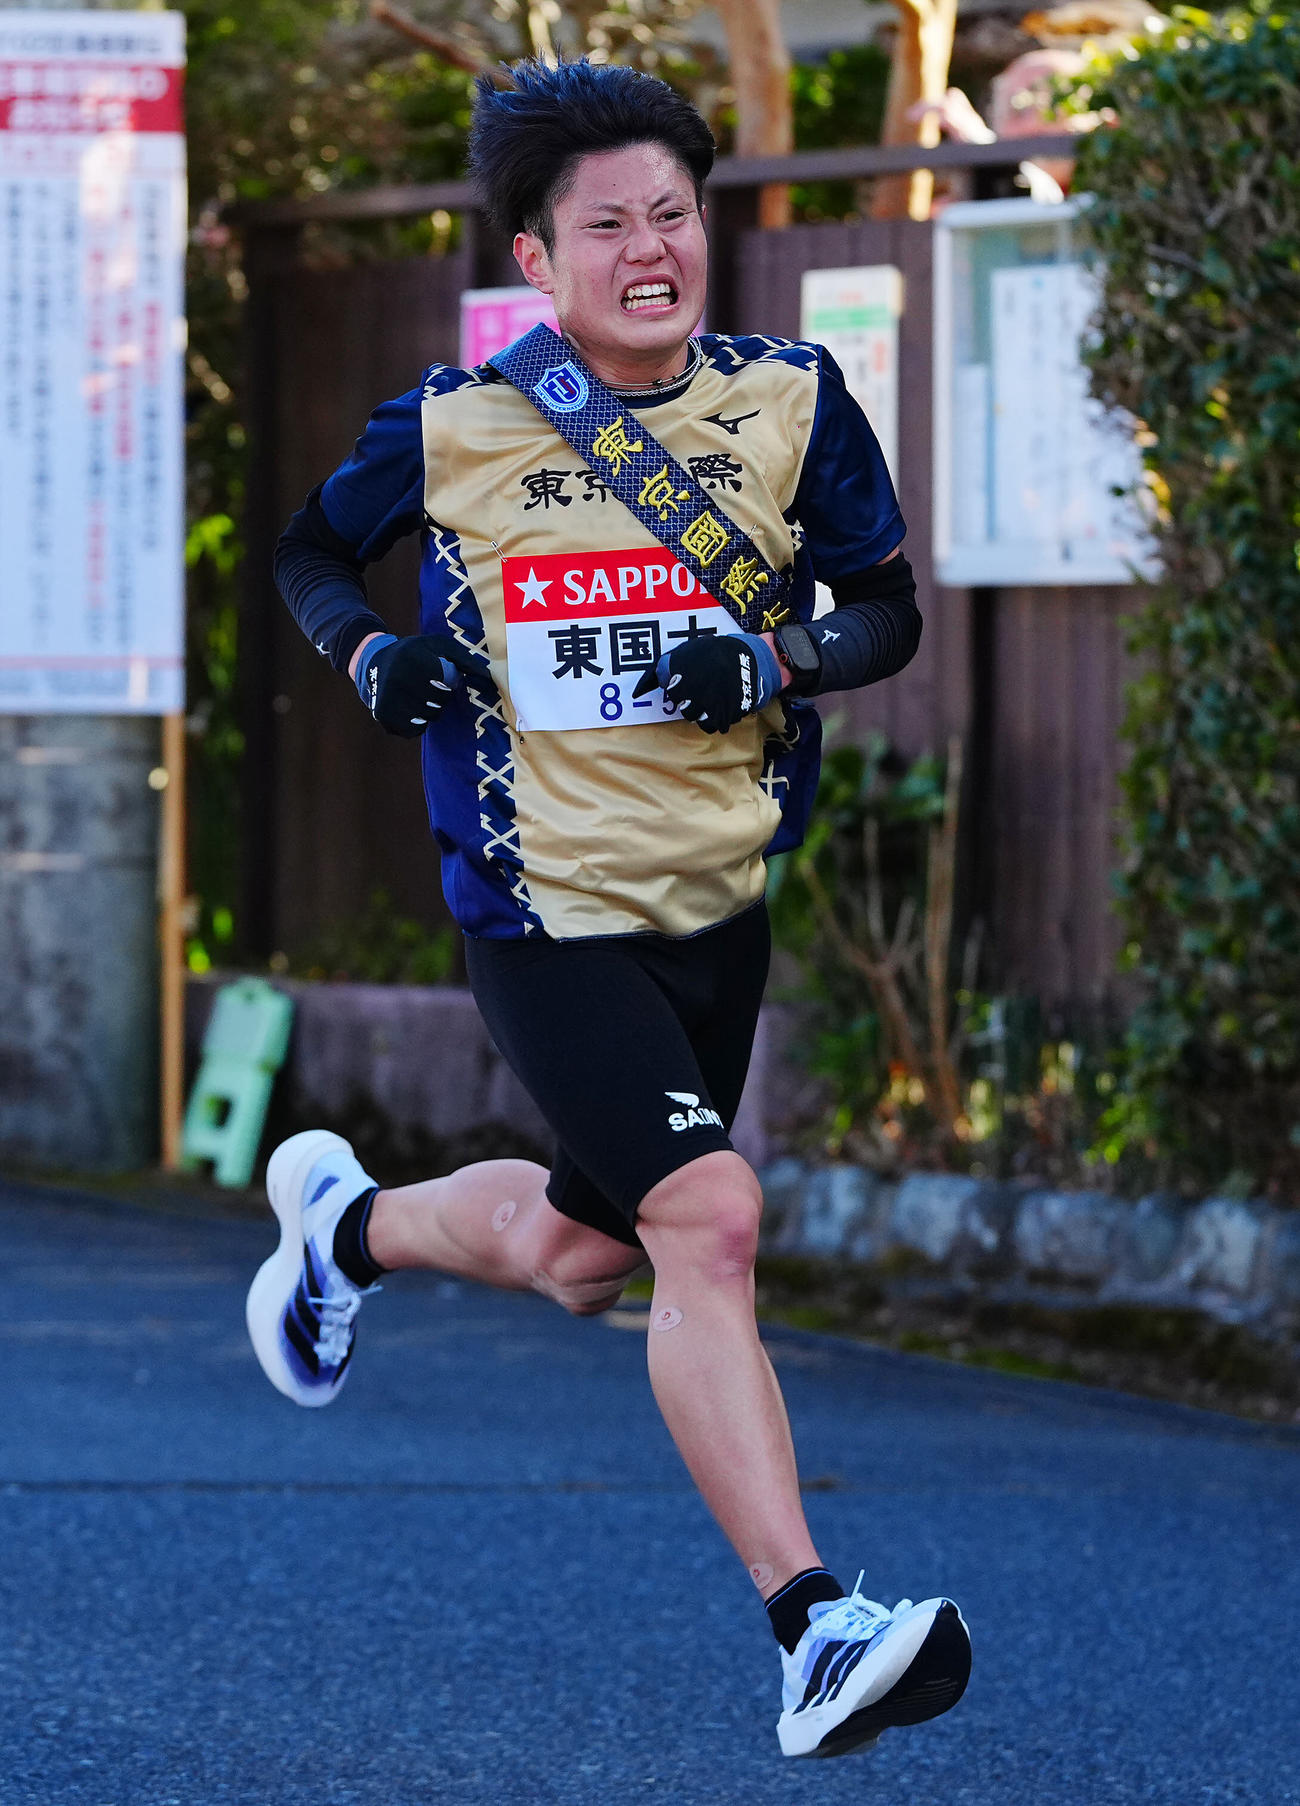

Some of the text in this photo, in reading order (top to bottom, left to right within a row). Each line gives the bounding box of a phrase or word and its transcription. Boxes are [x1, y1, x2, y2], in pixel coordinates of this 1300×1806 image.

[521, 454, 742, 510] 東京際
[562, 564, 708, 606] SAPPO
